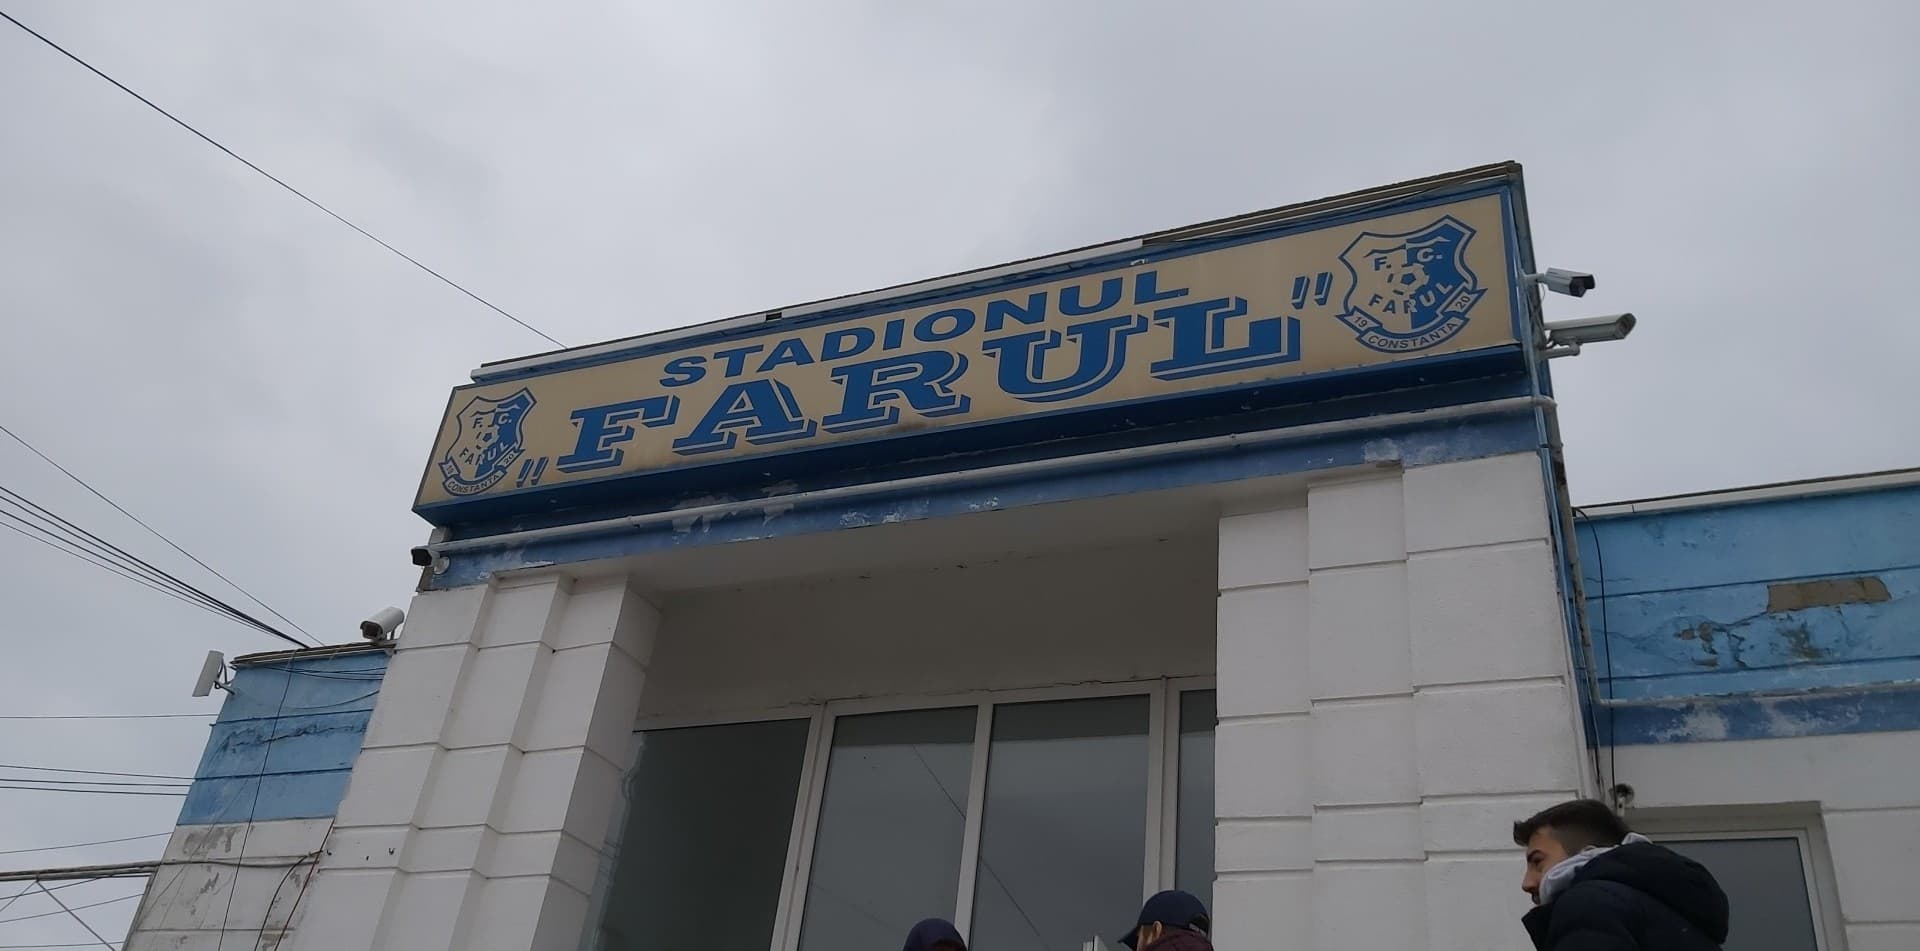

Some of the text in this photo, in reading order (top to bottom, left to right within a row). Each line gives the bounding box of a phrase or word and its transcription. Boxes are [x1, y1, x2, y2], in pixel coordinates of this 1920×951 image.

[1368, 282, 1453, 314] FARUL
[1456, 295, 1471, 310] 20
[660, 270, 1189, 388] STADIONUL
[1354, 315, 1369, 329] 19
[1368, 321, 1458, 349] CONSTANTA
[459, 442, 509, 466] FARUL
[447, 475, 500, 493] CONSTANTA
